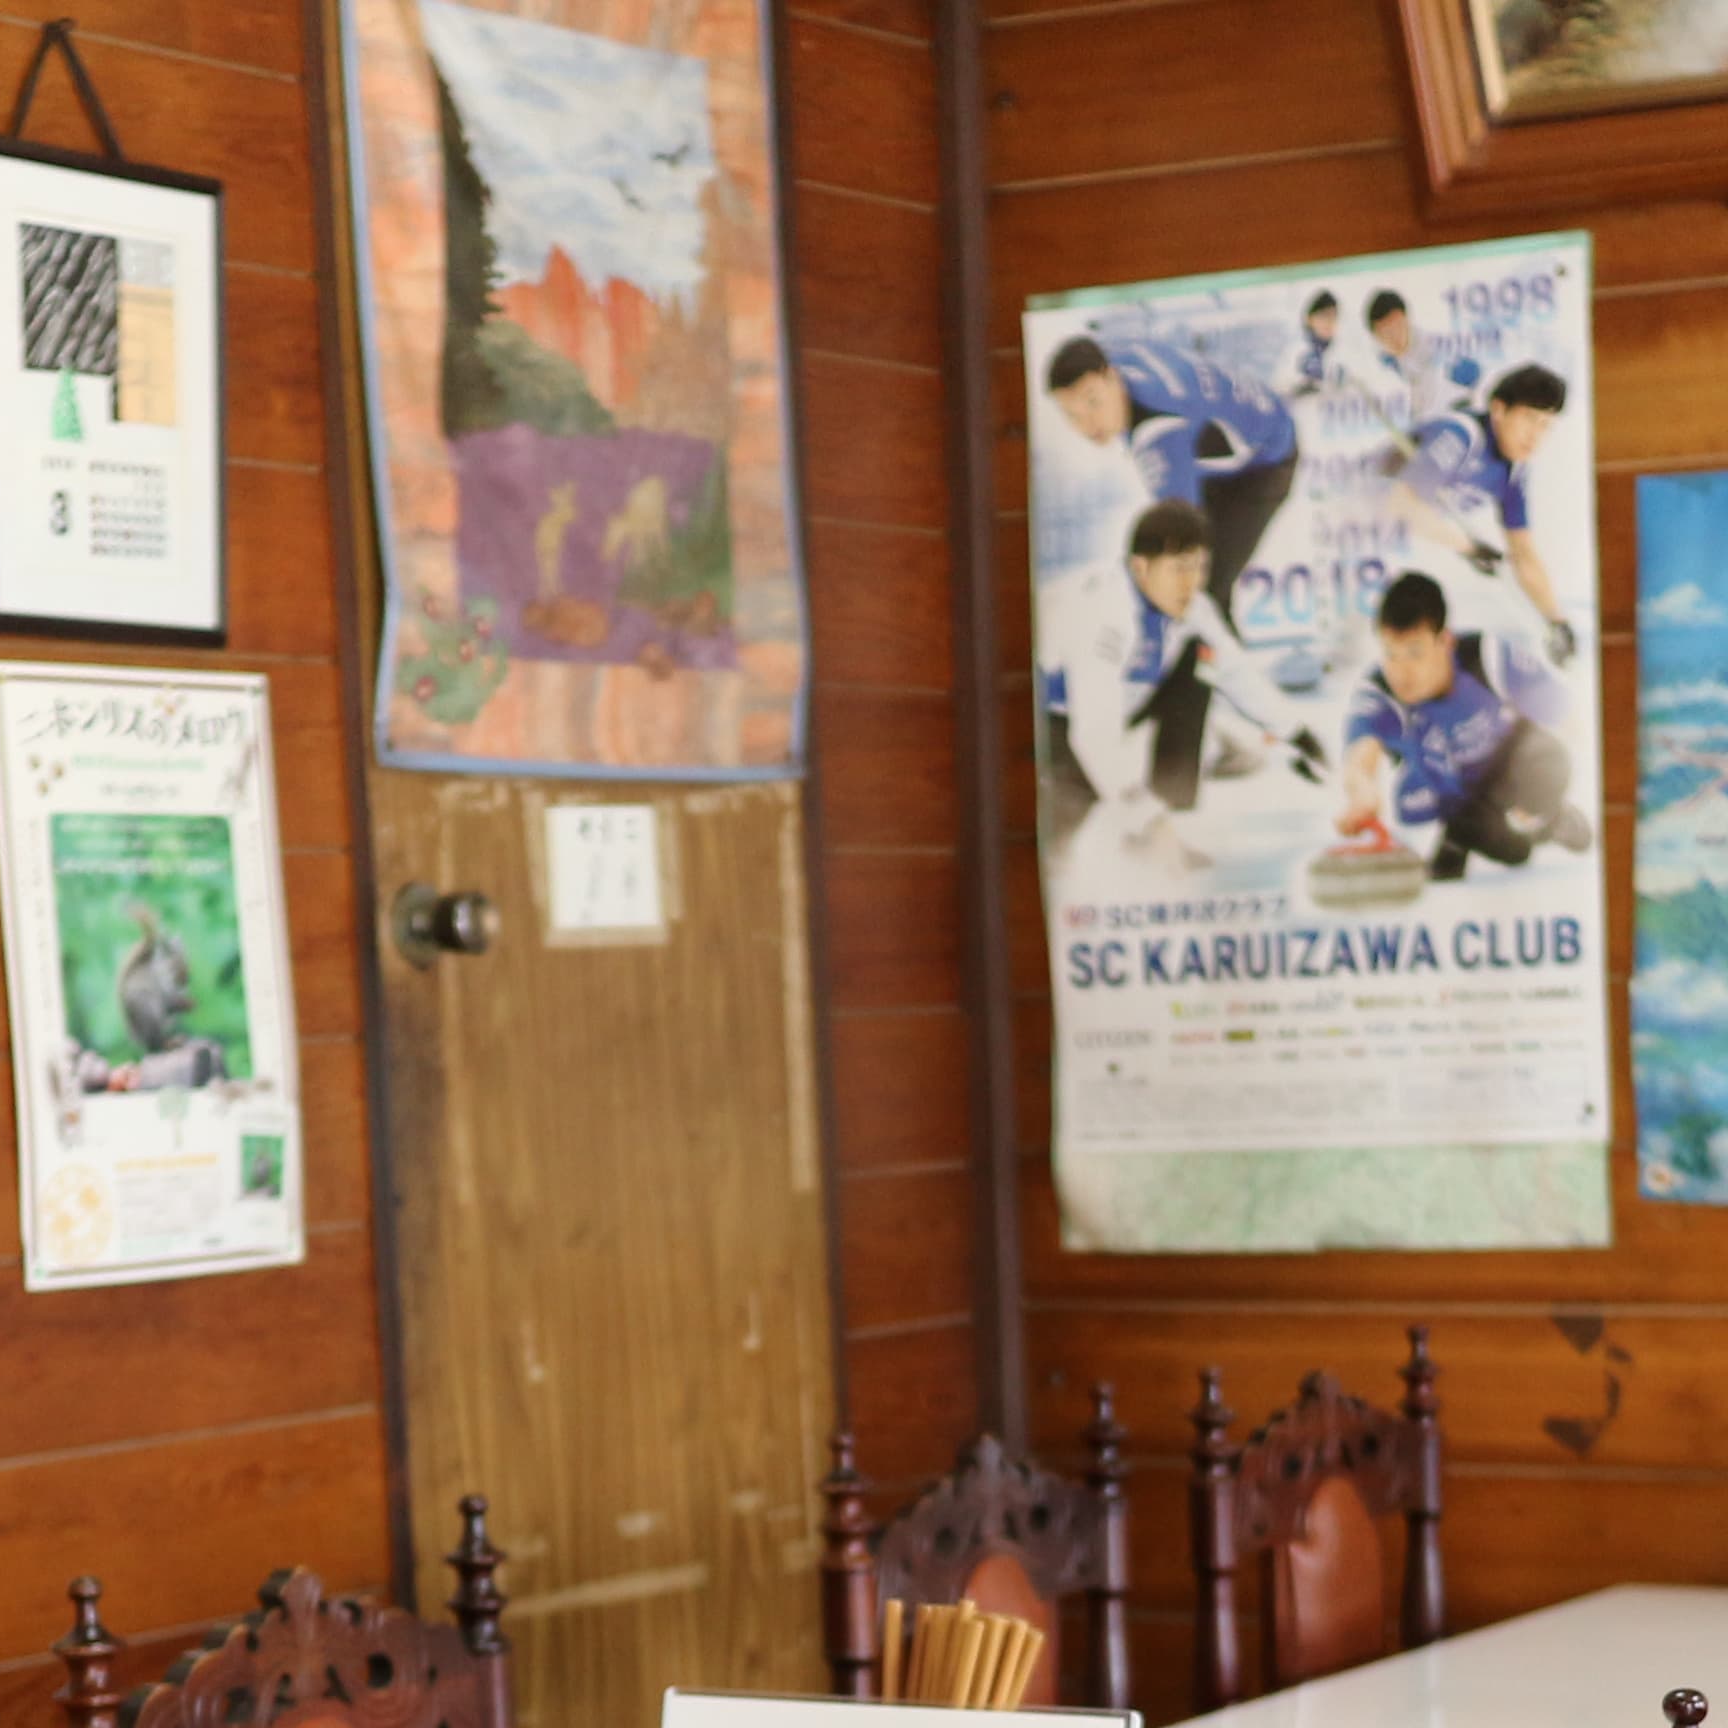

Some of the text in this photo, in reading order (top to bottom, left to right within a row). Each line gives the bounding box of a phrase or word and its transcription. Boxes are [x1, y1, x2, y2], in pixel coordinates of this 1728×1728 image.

[1444, 275, 1556, 326] 1998
[1241, 556, 1389, 626] 2018
[1069, 916, 1583, 989] SC KARUIZAWA CLUB
